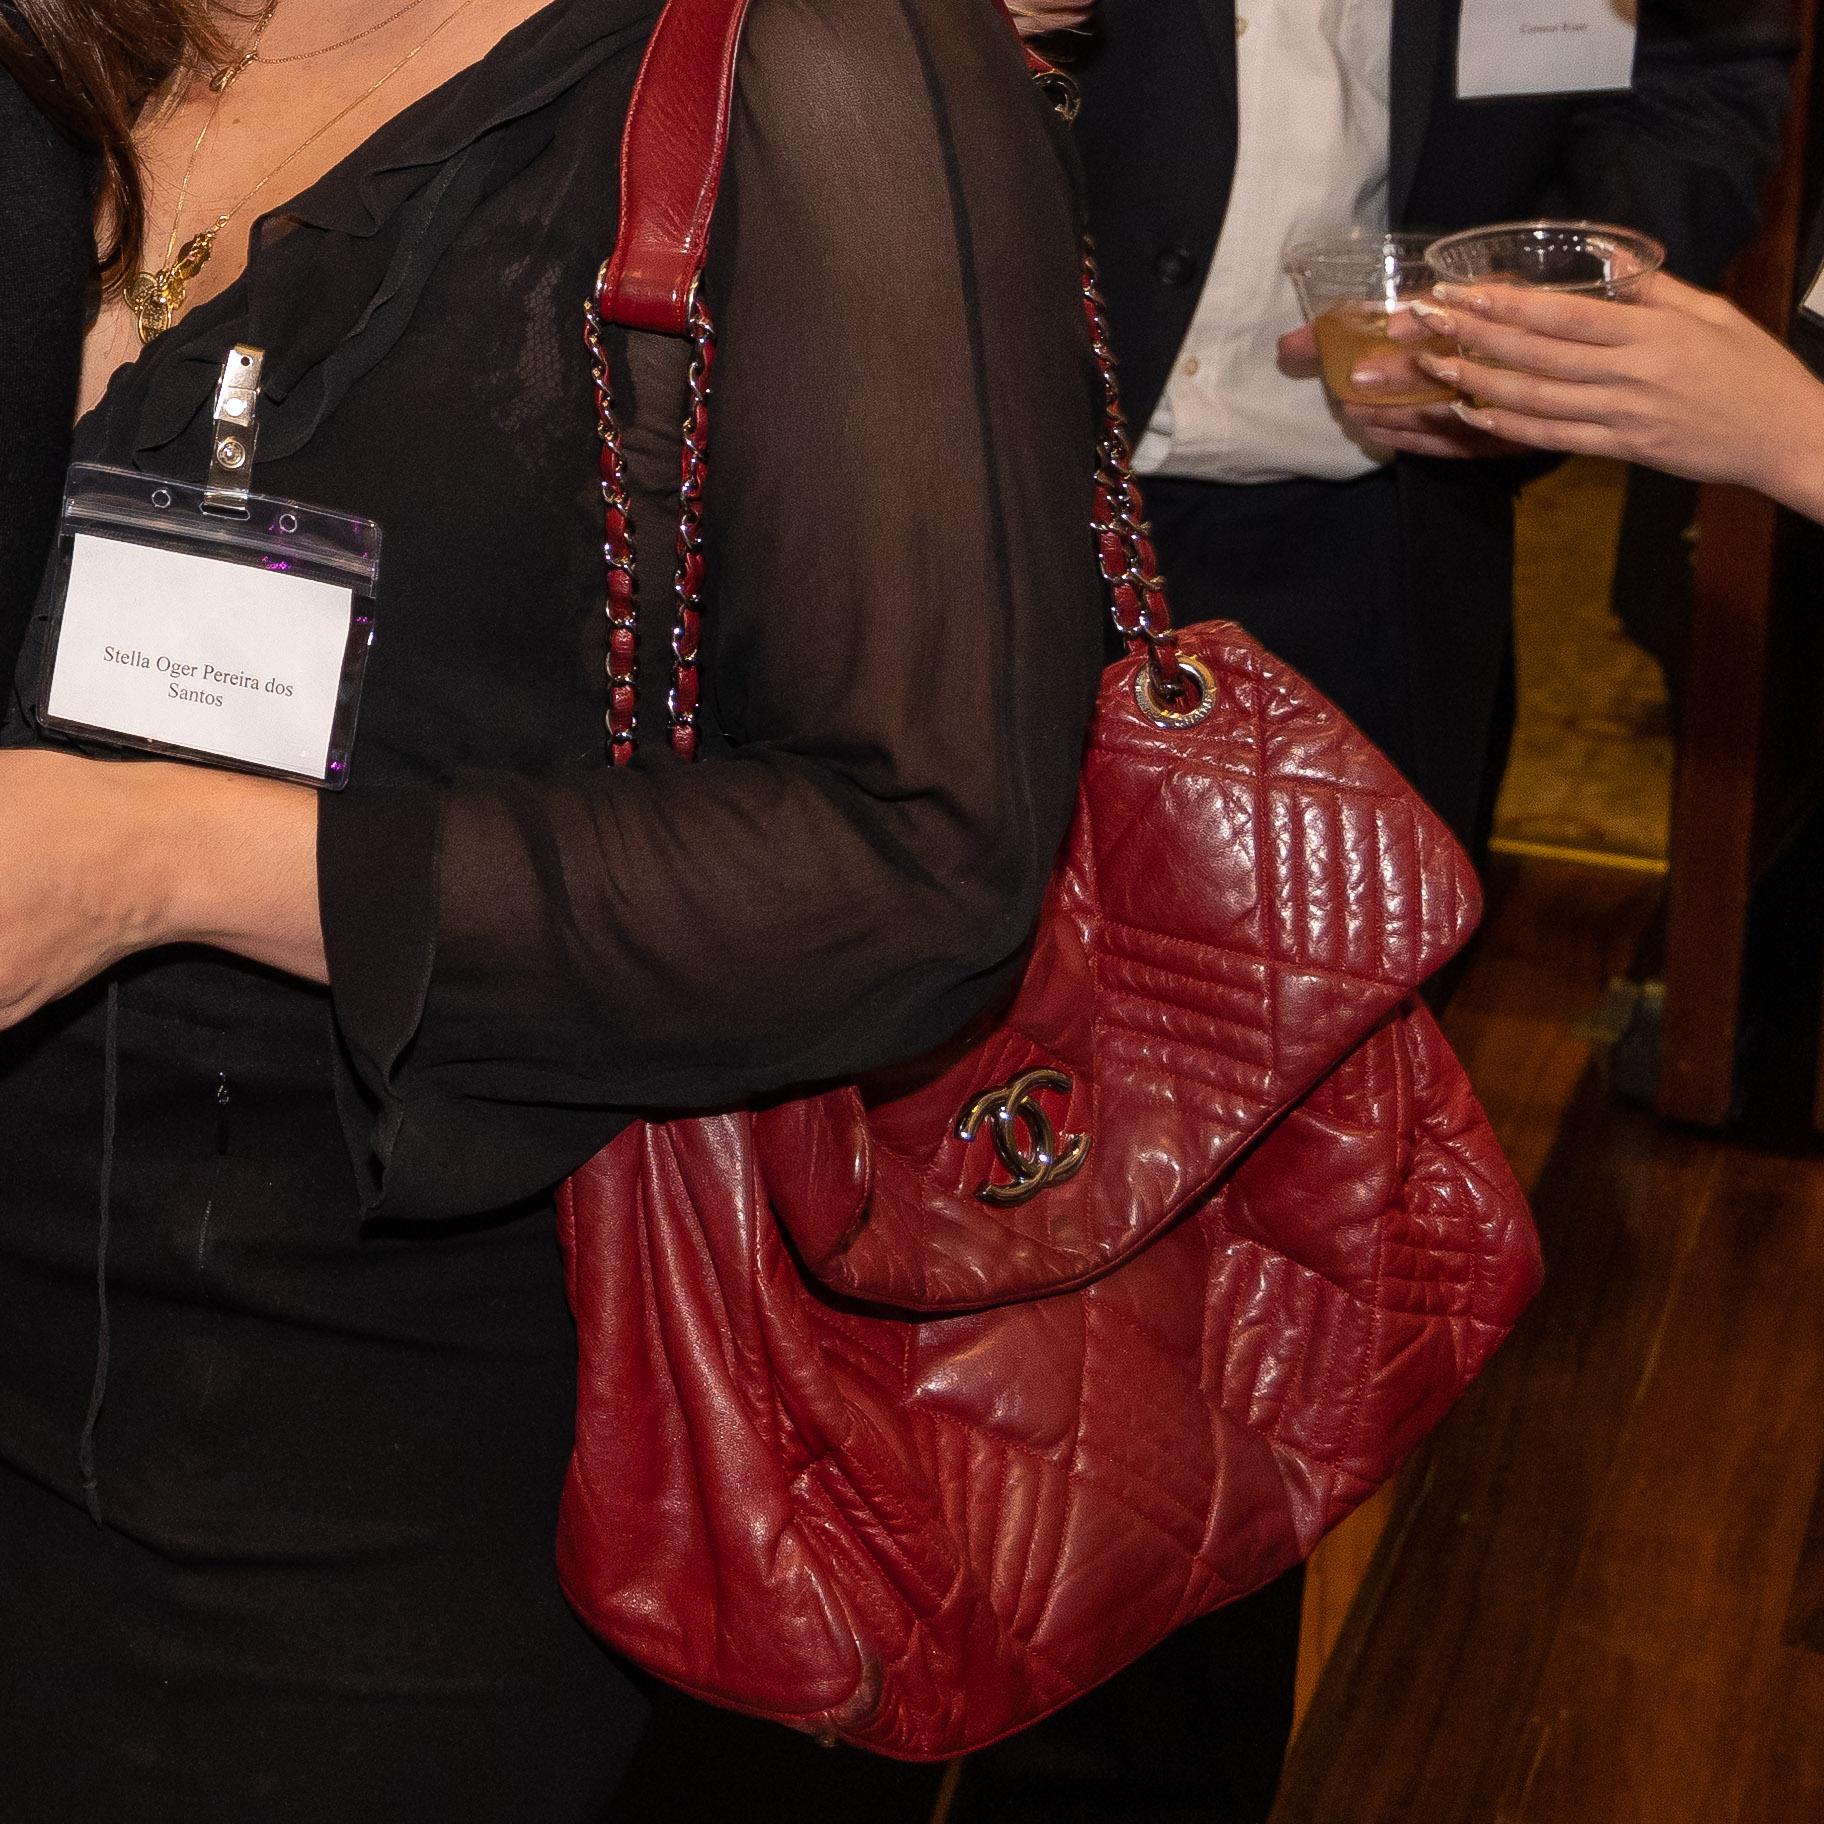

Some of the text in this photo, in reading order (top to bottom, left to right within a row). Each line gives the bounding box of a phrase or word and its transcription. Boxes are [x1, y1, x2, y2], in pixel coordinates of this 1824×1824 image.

[103, 646, 294, 697] Stella Oger Pereira dos
[168, 682, 224, 707] Santos
